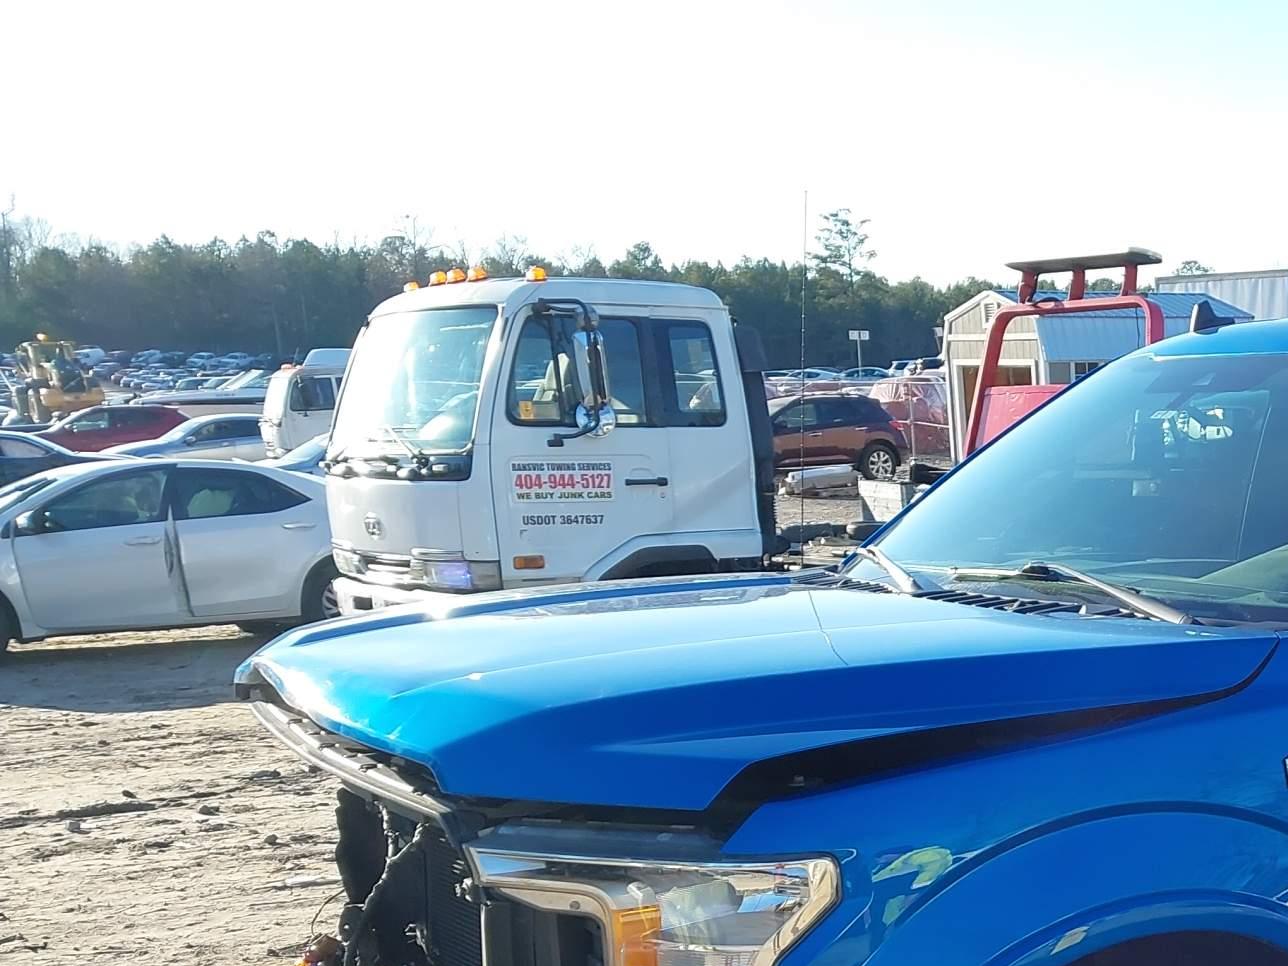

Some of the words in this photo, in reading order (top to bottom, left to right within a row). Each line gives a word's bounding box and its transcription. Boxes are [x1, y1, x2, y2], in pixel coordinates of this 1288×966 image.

[546, 463, 576, 471] TOWING
[577, 462, 612, 471] SERVICES
[515, 473, 611, 490] 404-944-5127
[516, 492, 532, 500] WE
[534, 492, 555, 500] BUY
[558, 491, 584, 499] JUNK
[586, 491, 612, 499] CARS
[522, 515, 557, 526] USDOT
[559, 514, 605, 525] 3647637
